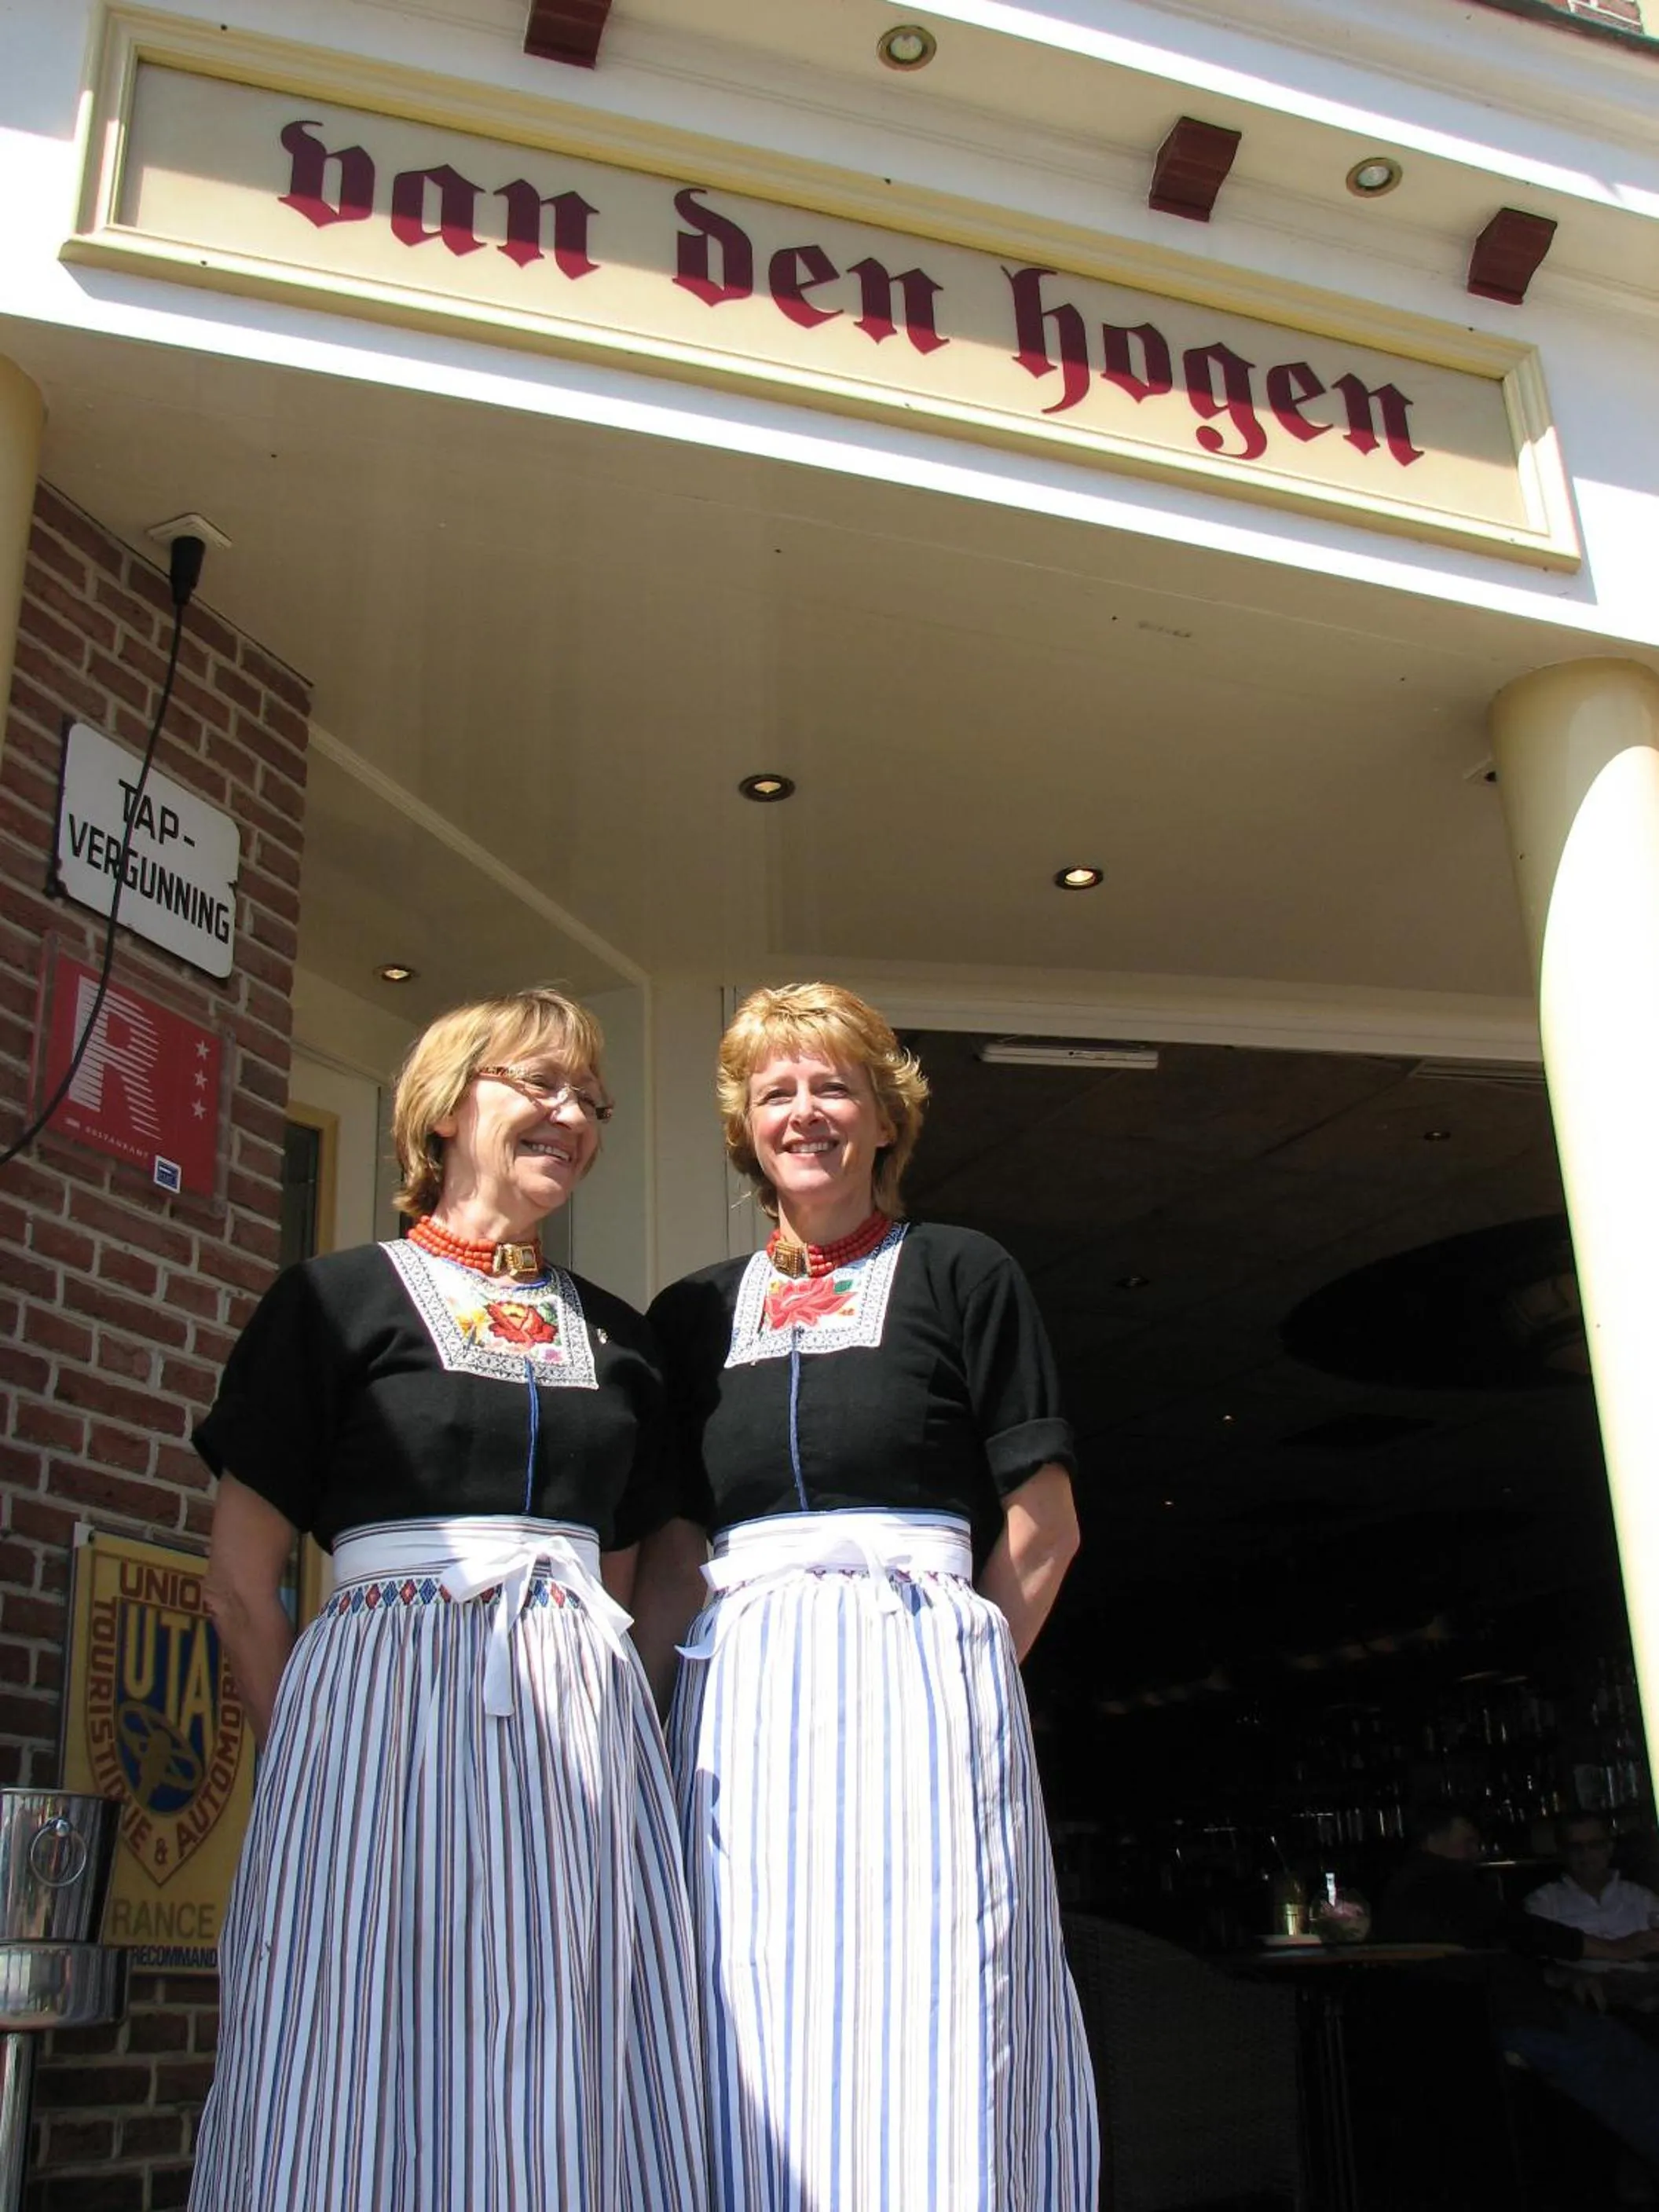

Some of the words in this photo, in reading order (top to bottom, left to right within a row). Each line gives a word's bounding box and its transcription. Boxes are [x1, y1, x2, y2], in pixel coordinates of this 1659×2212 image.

[119, 778, 196, 848] TAP-
[68, 813, 230, 944] VERGUNNING
[119, 1559, 214, 1614] UNIO
[123, 1603, 214, 1760] UTA
[112, 1897, 215, 1939] RANCE
[131, 1945, 218, 1968] RECOMMAND
